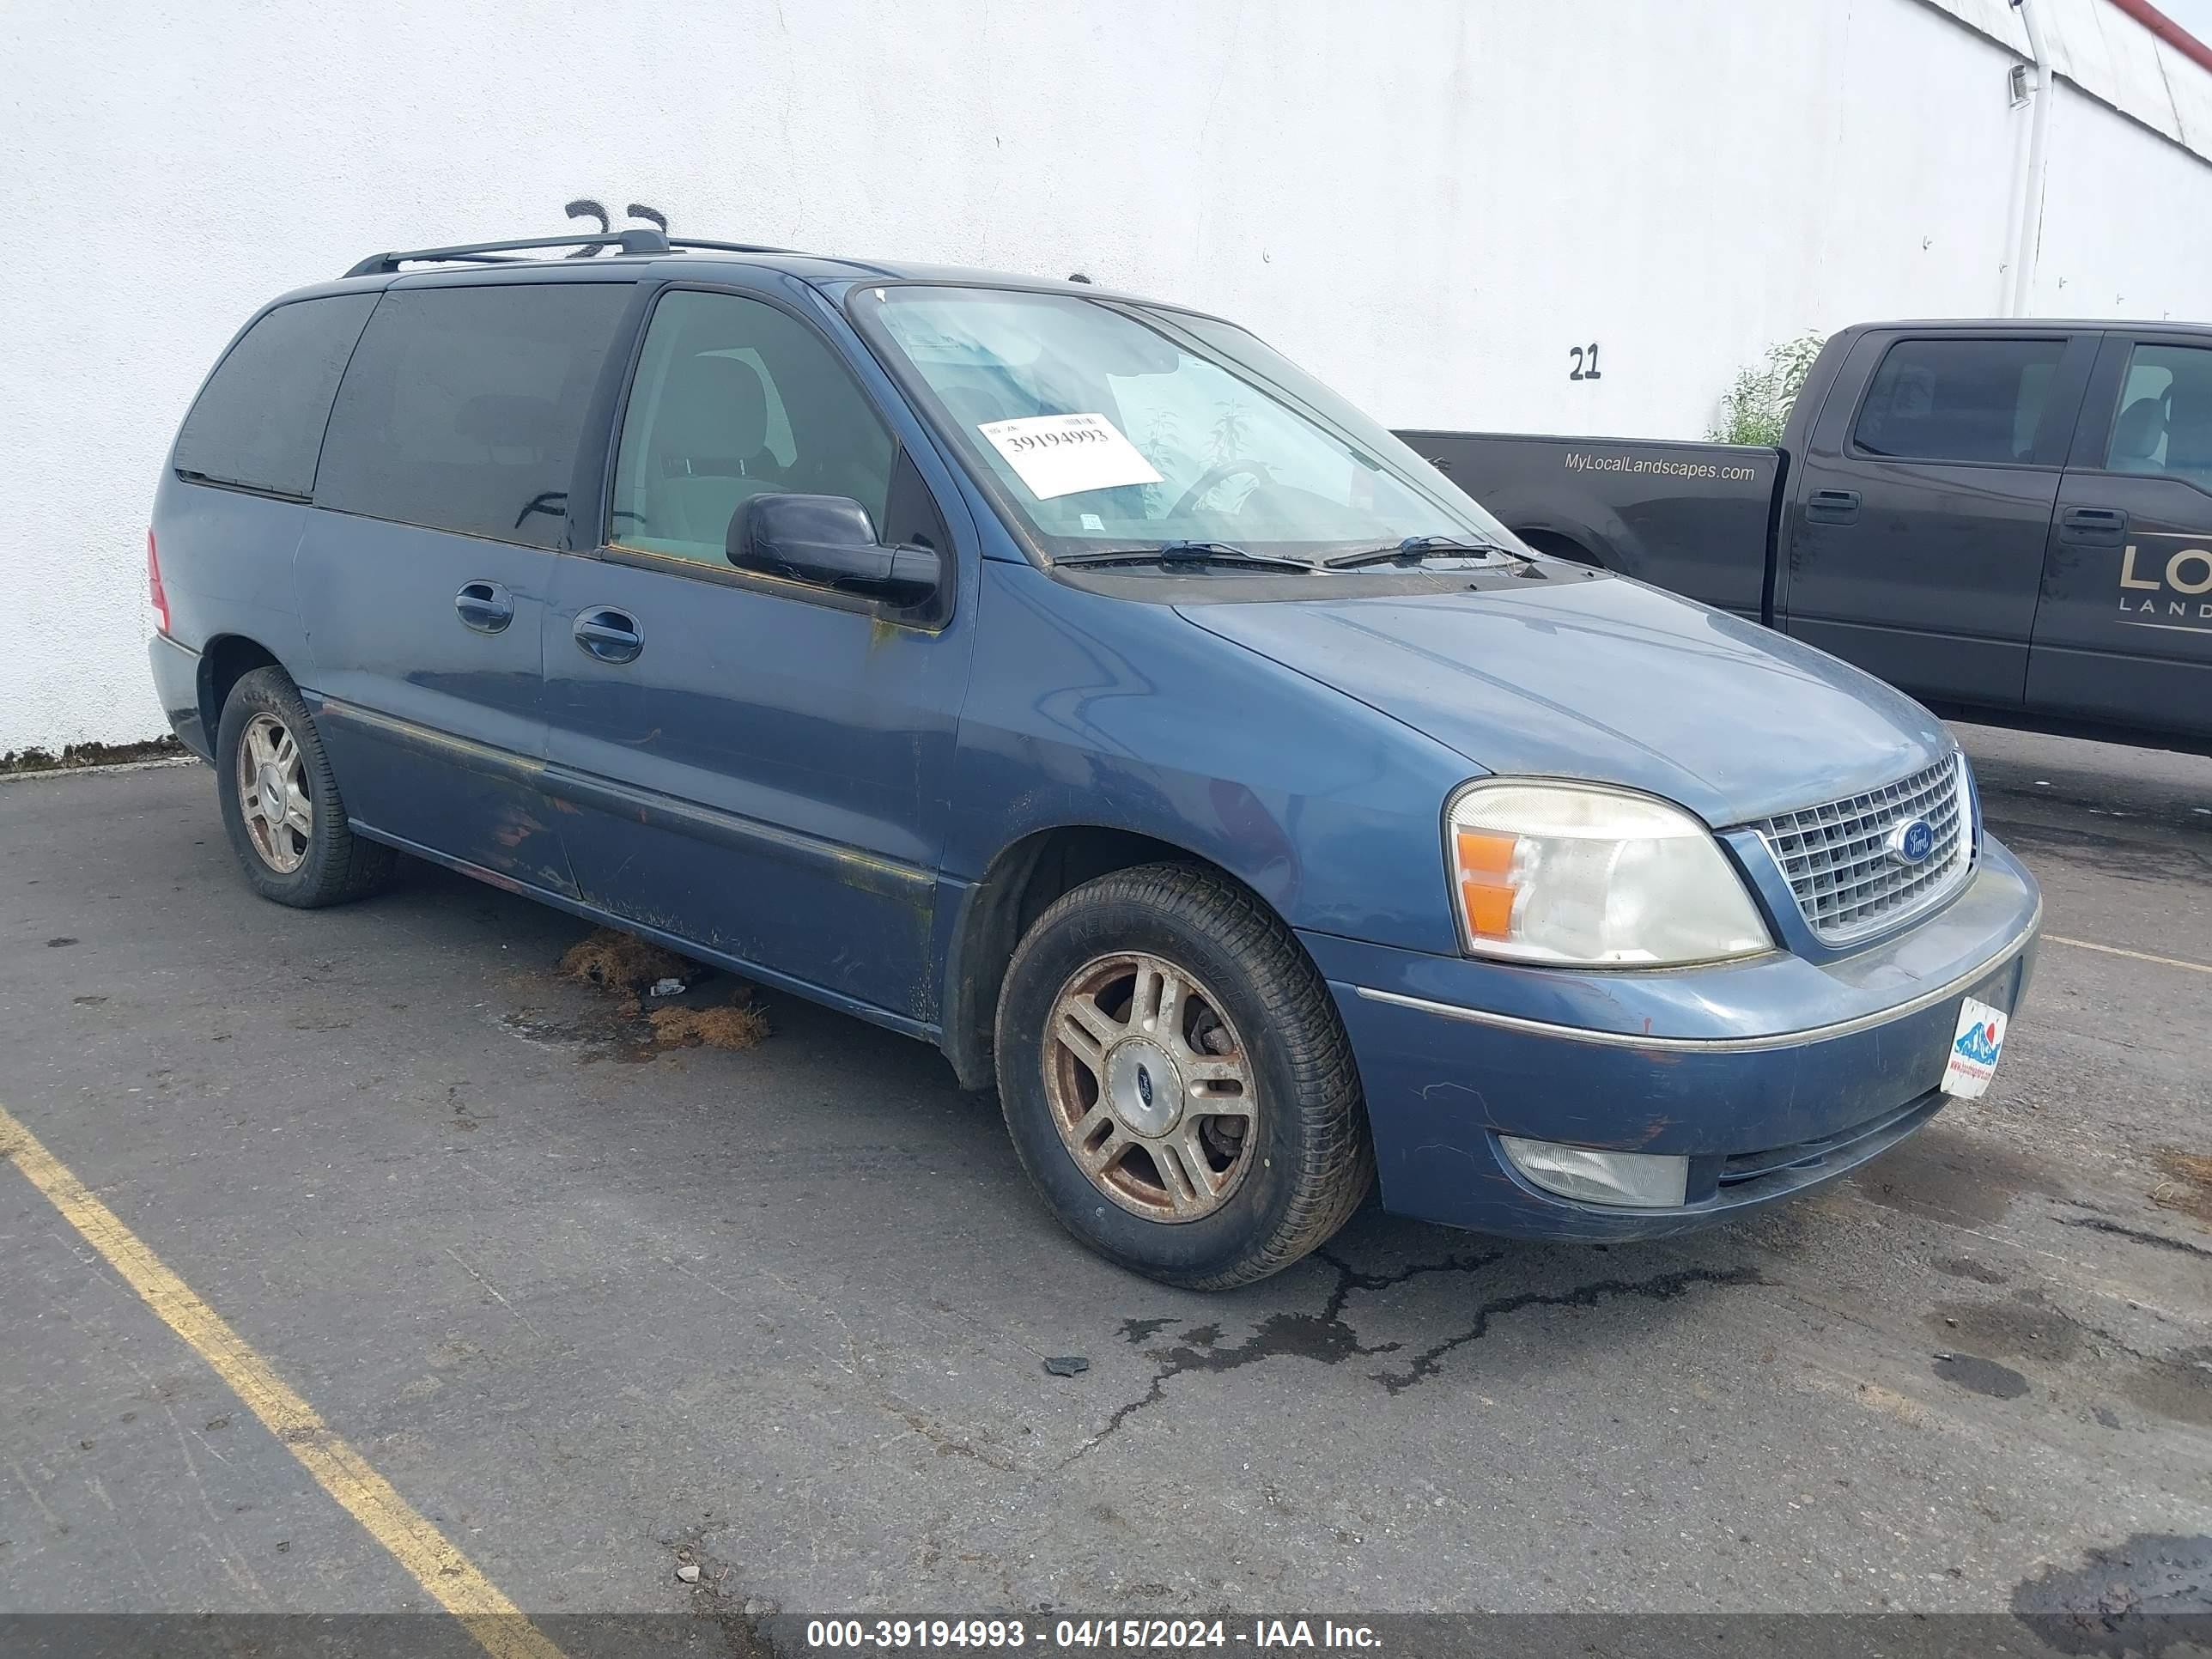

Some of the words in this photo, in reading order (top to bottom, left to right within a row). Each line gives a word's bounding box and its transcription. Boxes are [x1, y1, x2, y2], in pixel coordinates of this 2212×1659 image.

[1569, 343, 1601, 380] 21
[1007, 429, 1109, 453] 39194993
[1565, 453, 1755, 482] MyLocalLandscapes.com
[1909, 828, 1929, 855] Ford
